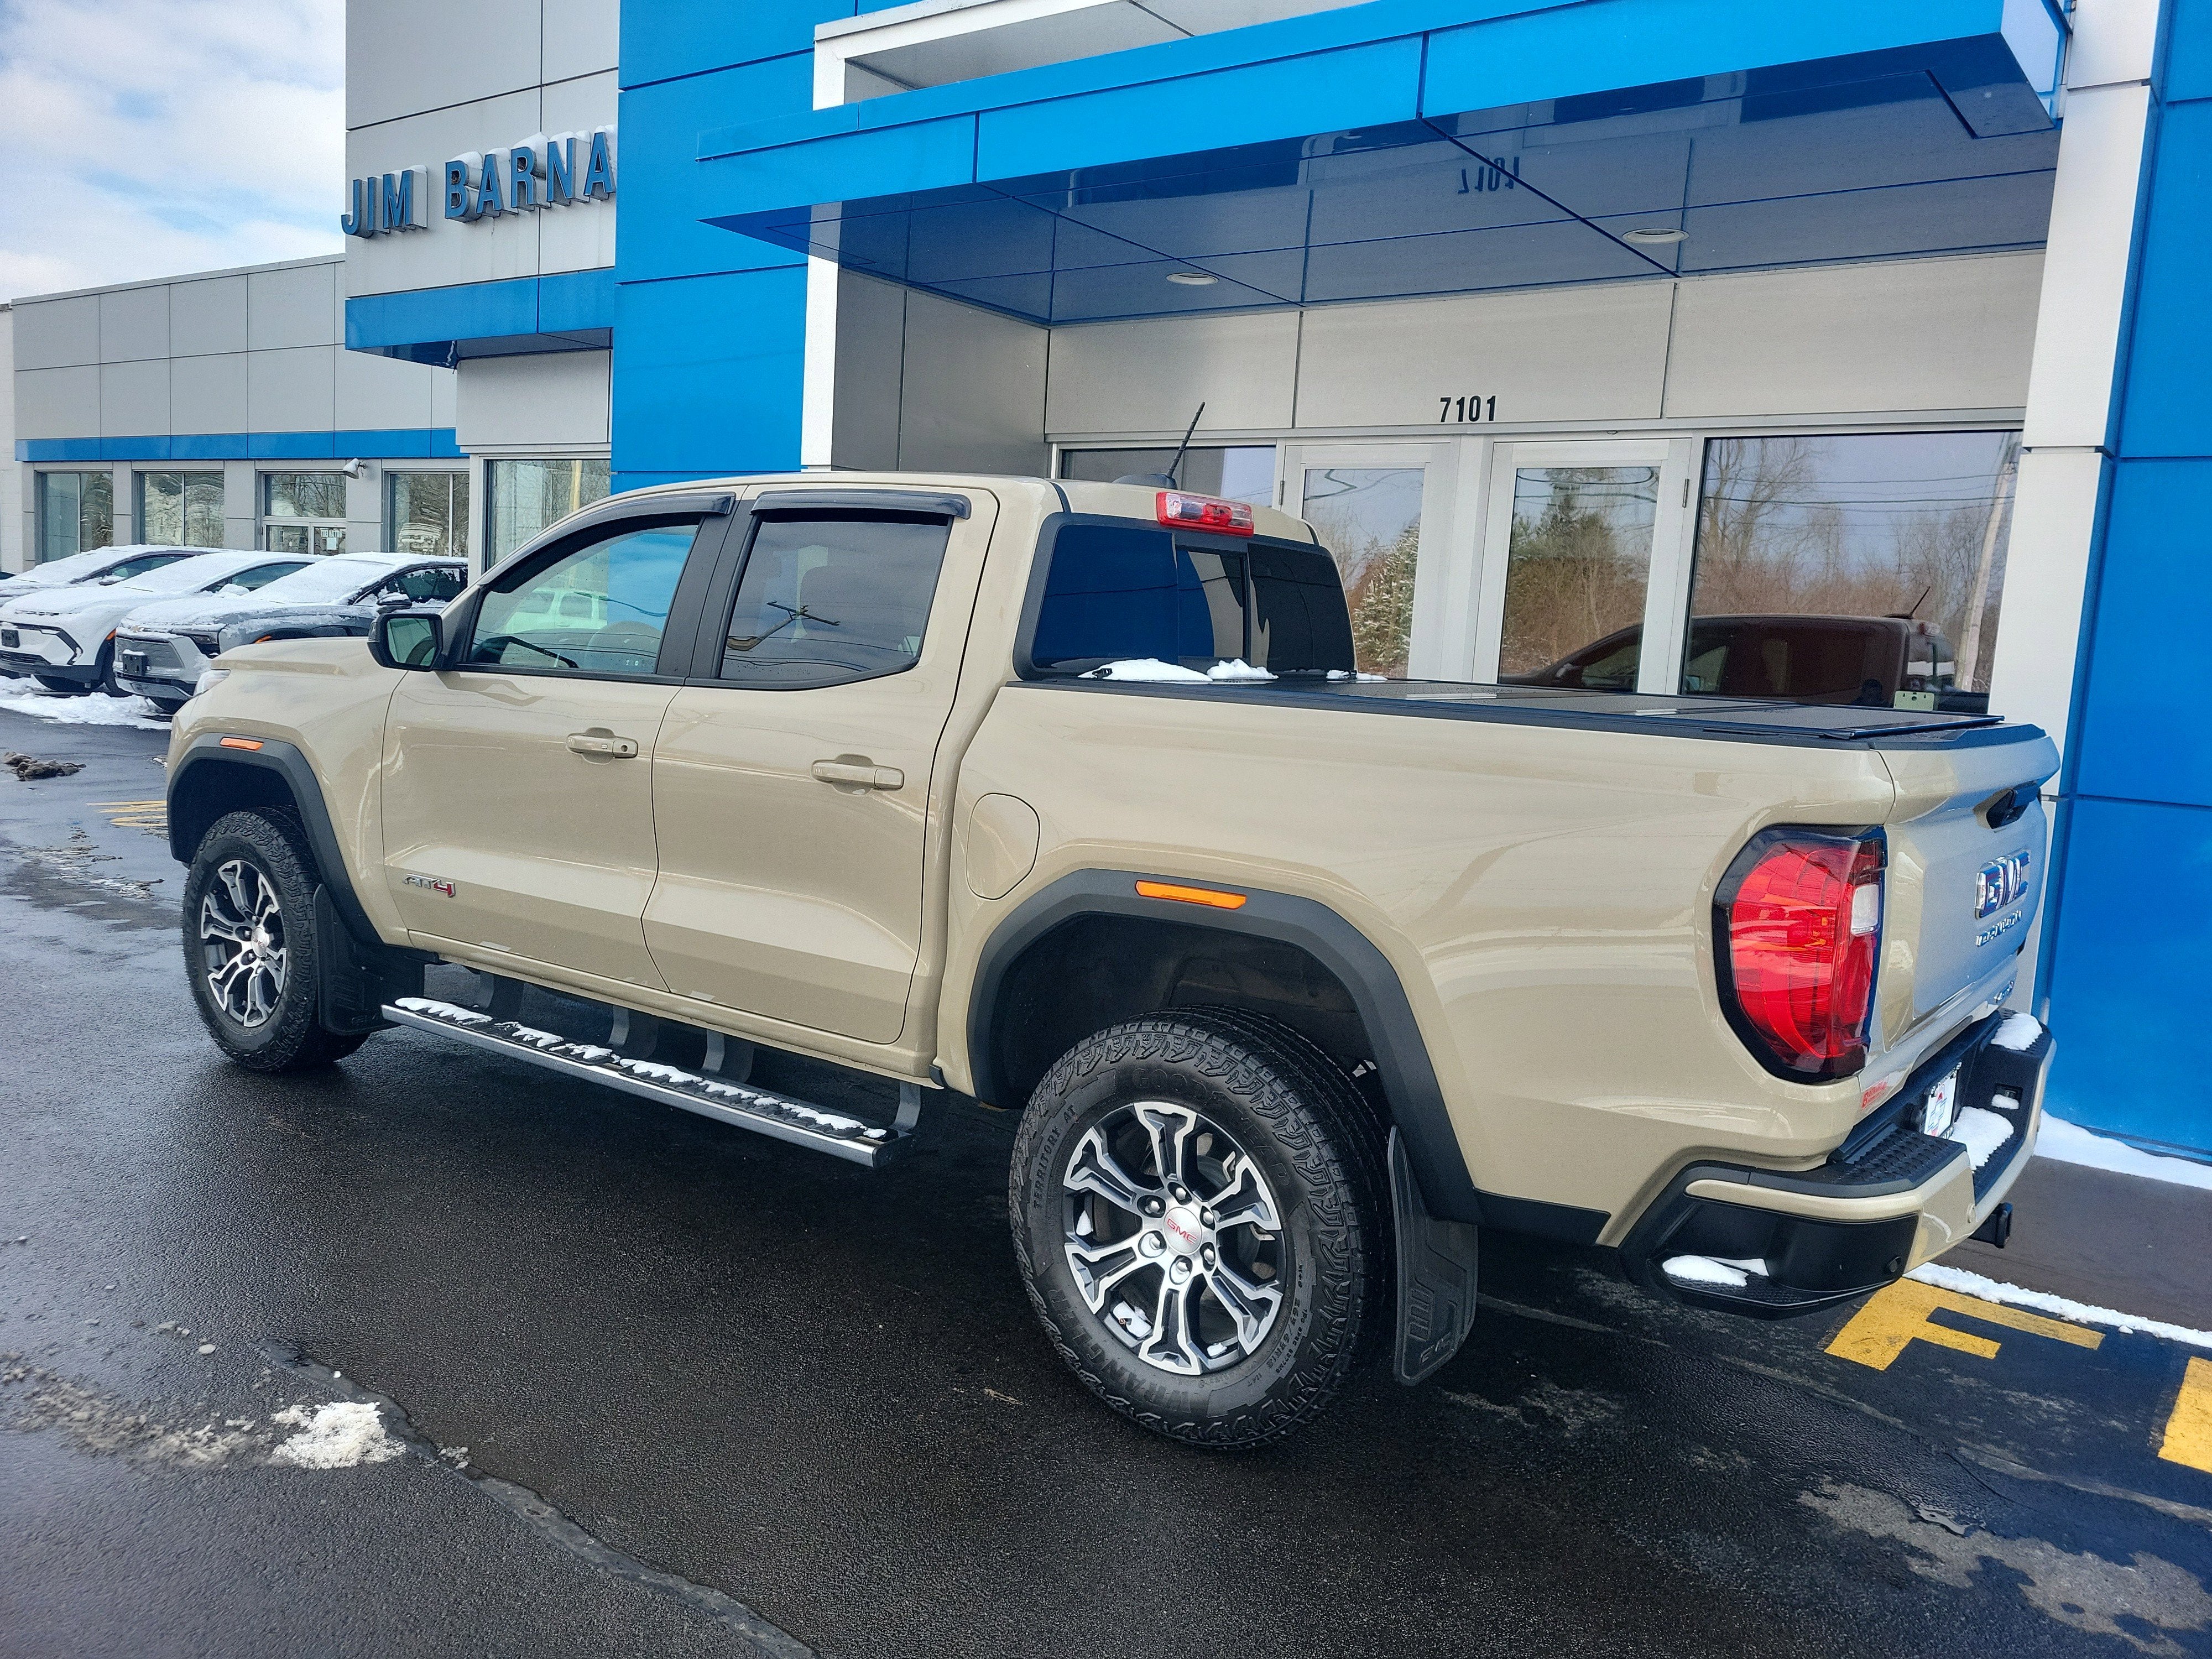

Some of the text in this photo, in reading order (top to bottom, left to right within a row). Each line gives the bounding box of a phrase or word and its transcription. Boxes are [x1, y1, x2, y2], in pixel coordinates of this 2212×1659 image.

[341, 132, 617, 237] JIM BARNA
[1440, 395, 1496, 422] 7101
[1033, 1104, 1076, 1209] TERRITORY AT
[1167, 1218, 1198, 1244] GMC
[1047, 1287, 1191, 1413] WRANGLER
